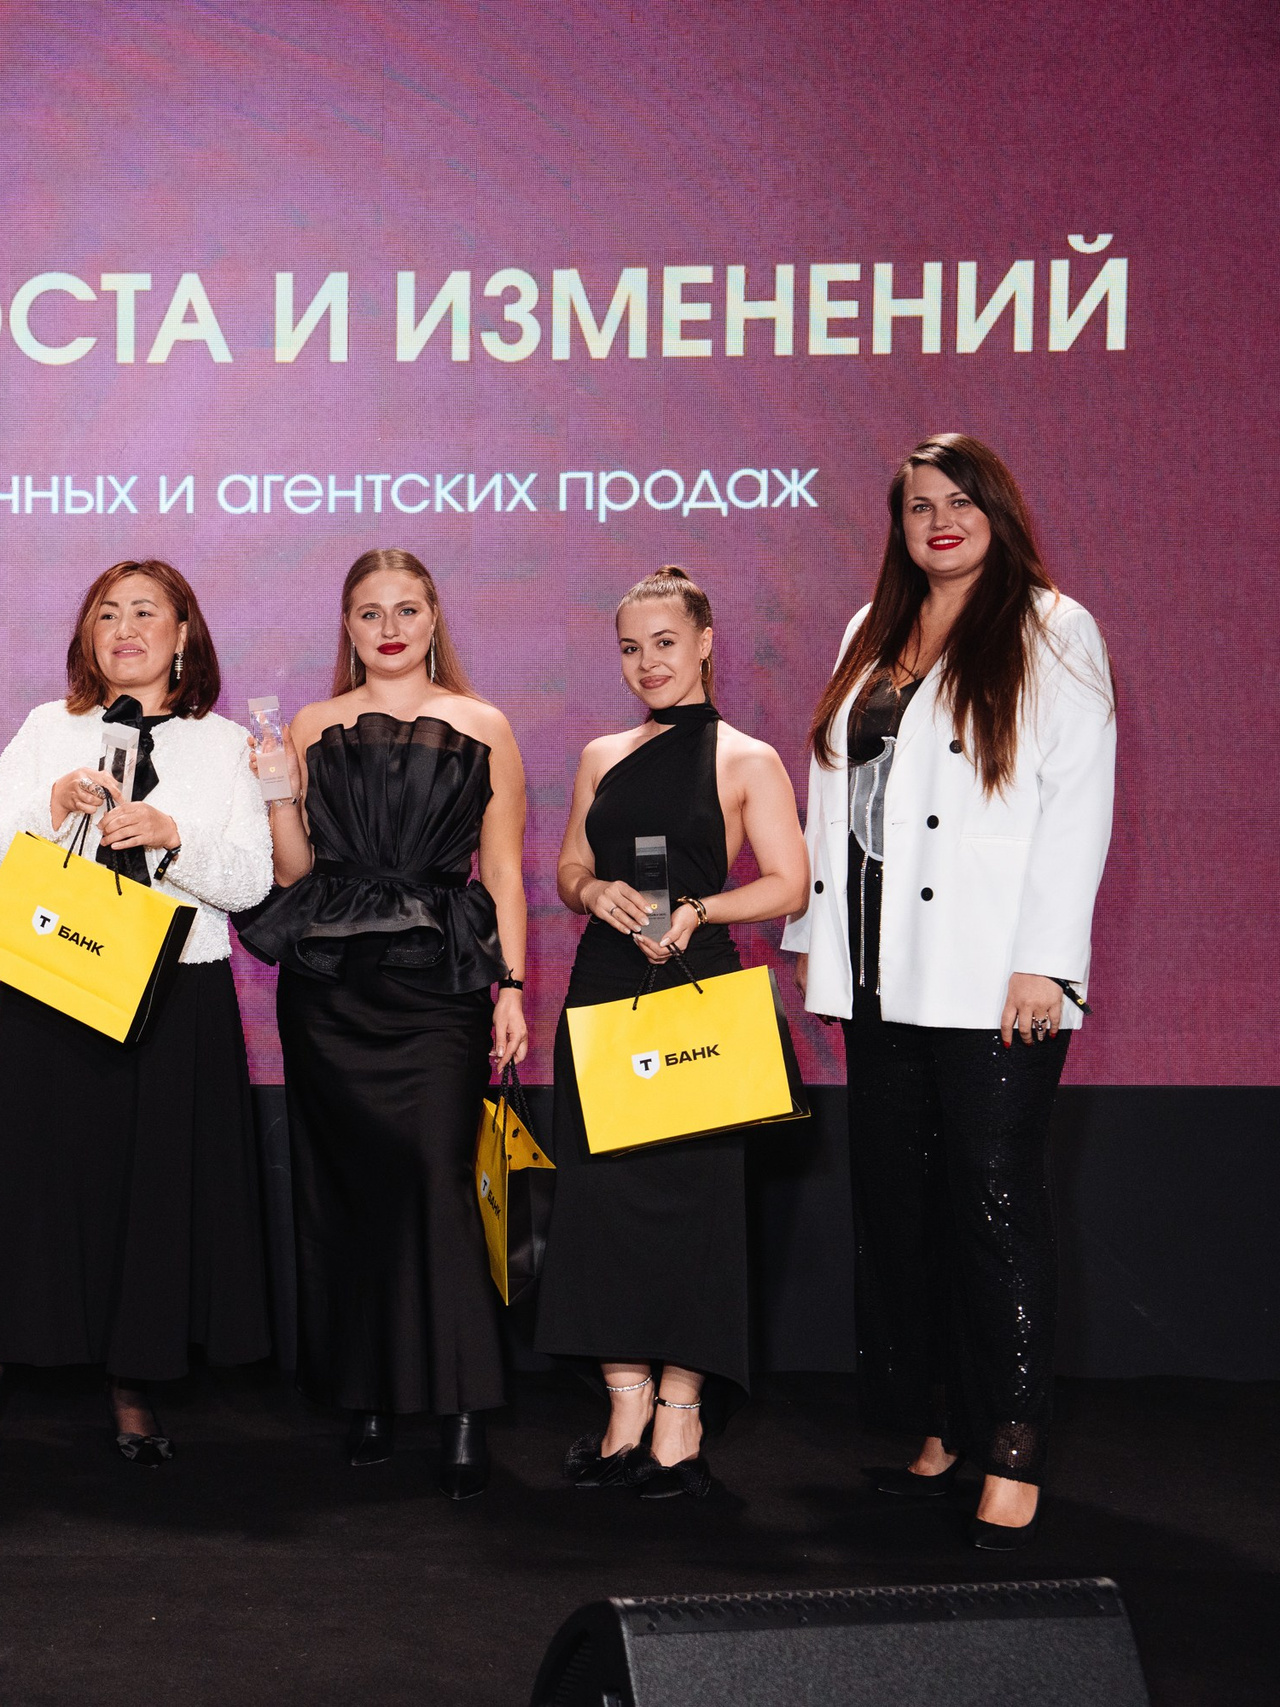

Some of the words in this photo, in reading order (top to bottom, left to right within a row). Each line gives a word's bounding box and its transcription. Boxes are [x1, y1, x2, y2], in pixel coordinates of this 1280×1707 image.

[274, 271, 349, 363] И
[396, 234, 1128, 362] ИЗМЕНЕНИЙ
[159, 475, 195, 514] и
[217, 473, 537, 515] агентских
[559, 468, 819, 523] продаж
[39, 914, 51, 928] Т
[57, 924, 105, 958] БАНК
[639, 1057, 652, 1071] Т
[664, 1044, 721, 1067] БАНК
